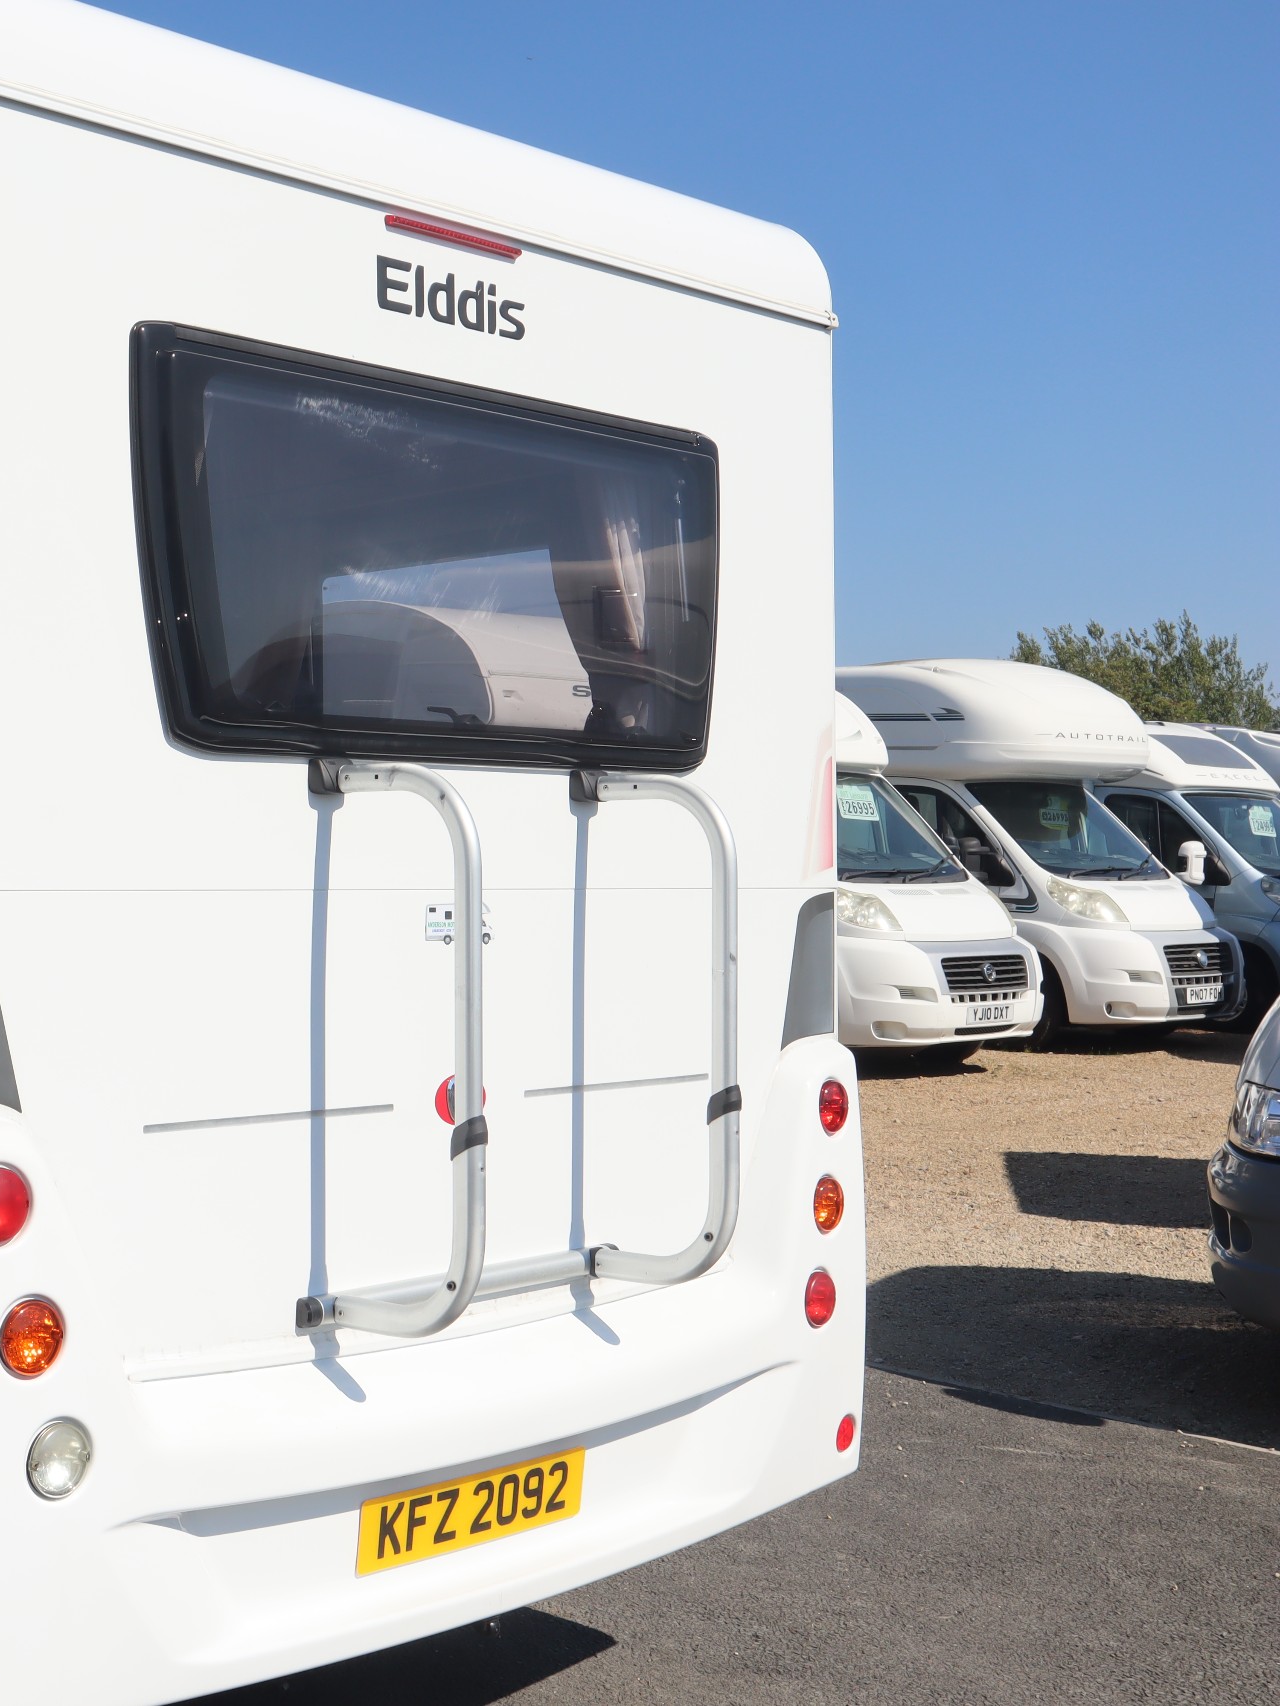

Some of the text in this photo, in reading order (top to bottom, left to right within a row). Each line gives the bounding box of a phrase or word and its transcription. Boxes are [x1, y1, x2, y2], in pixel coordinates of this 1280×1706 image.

[376, 254, 526, 341] Elddis
[1055, 731, 1147, 744] AUTOTRAIL
[973, 1006, 1010, 1021] YJ10 DXT
[376, 1460, 570, 1560] KFZ 2092
